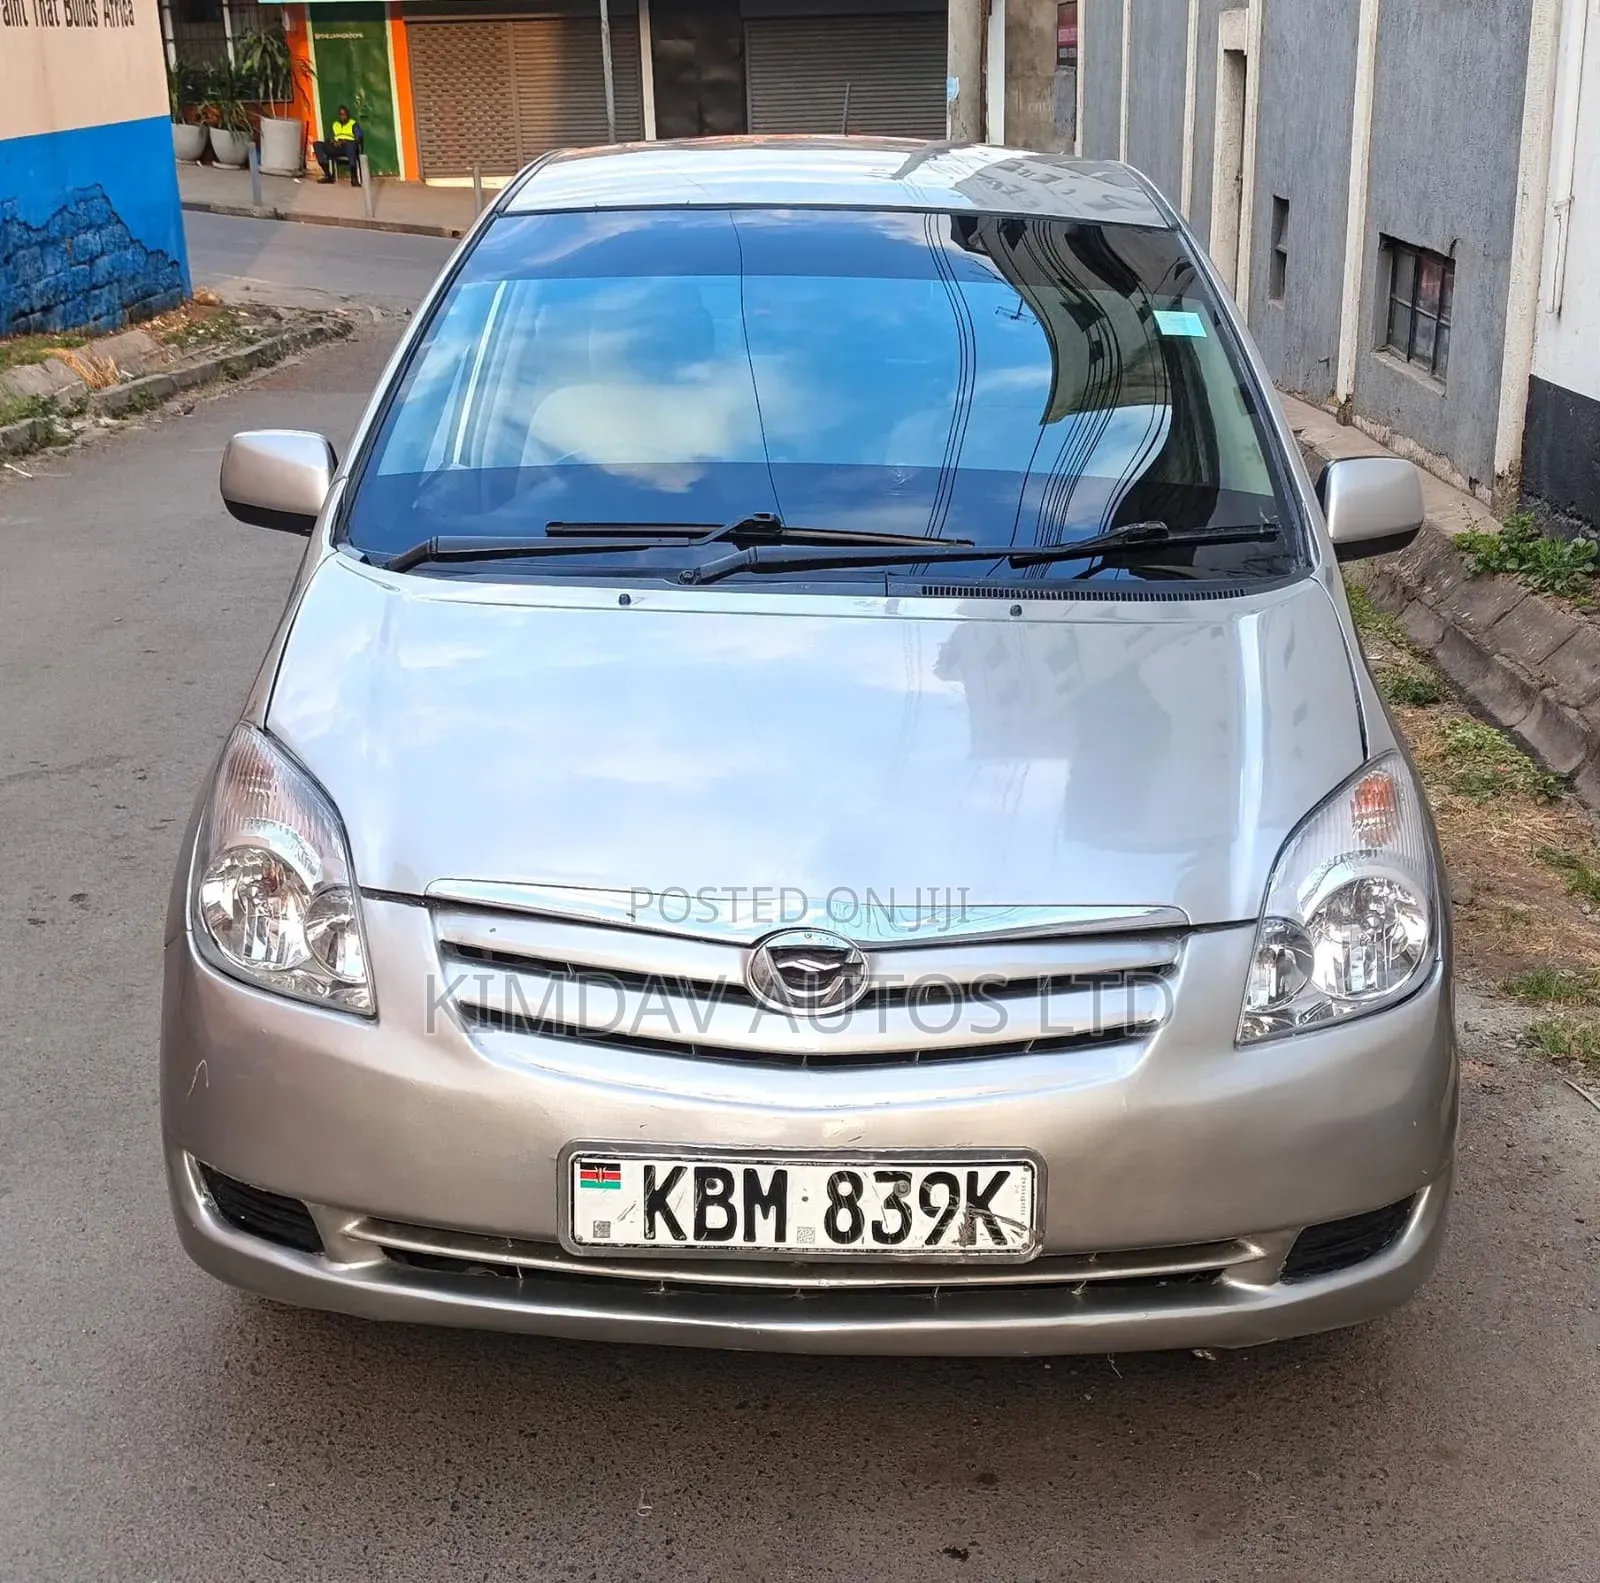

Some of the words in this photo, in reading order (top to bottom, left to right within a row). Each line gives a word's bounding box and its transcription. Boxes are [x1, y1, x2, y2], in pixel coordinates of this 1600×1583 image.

[32, 0, 60, 27] That
[63, 0, 98, 28] Builds
[103, 0, 135, 28] Africa
[643, 1164, 788, 1243] KBM
[824, 1170, 1011, 1247] 839K
